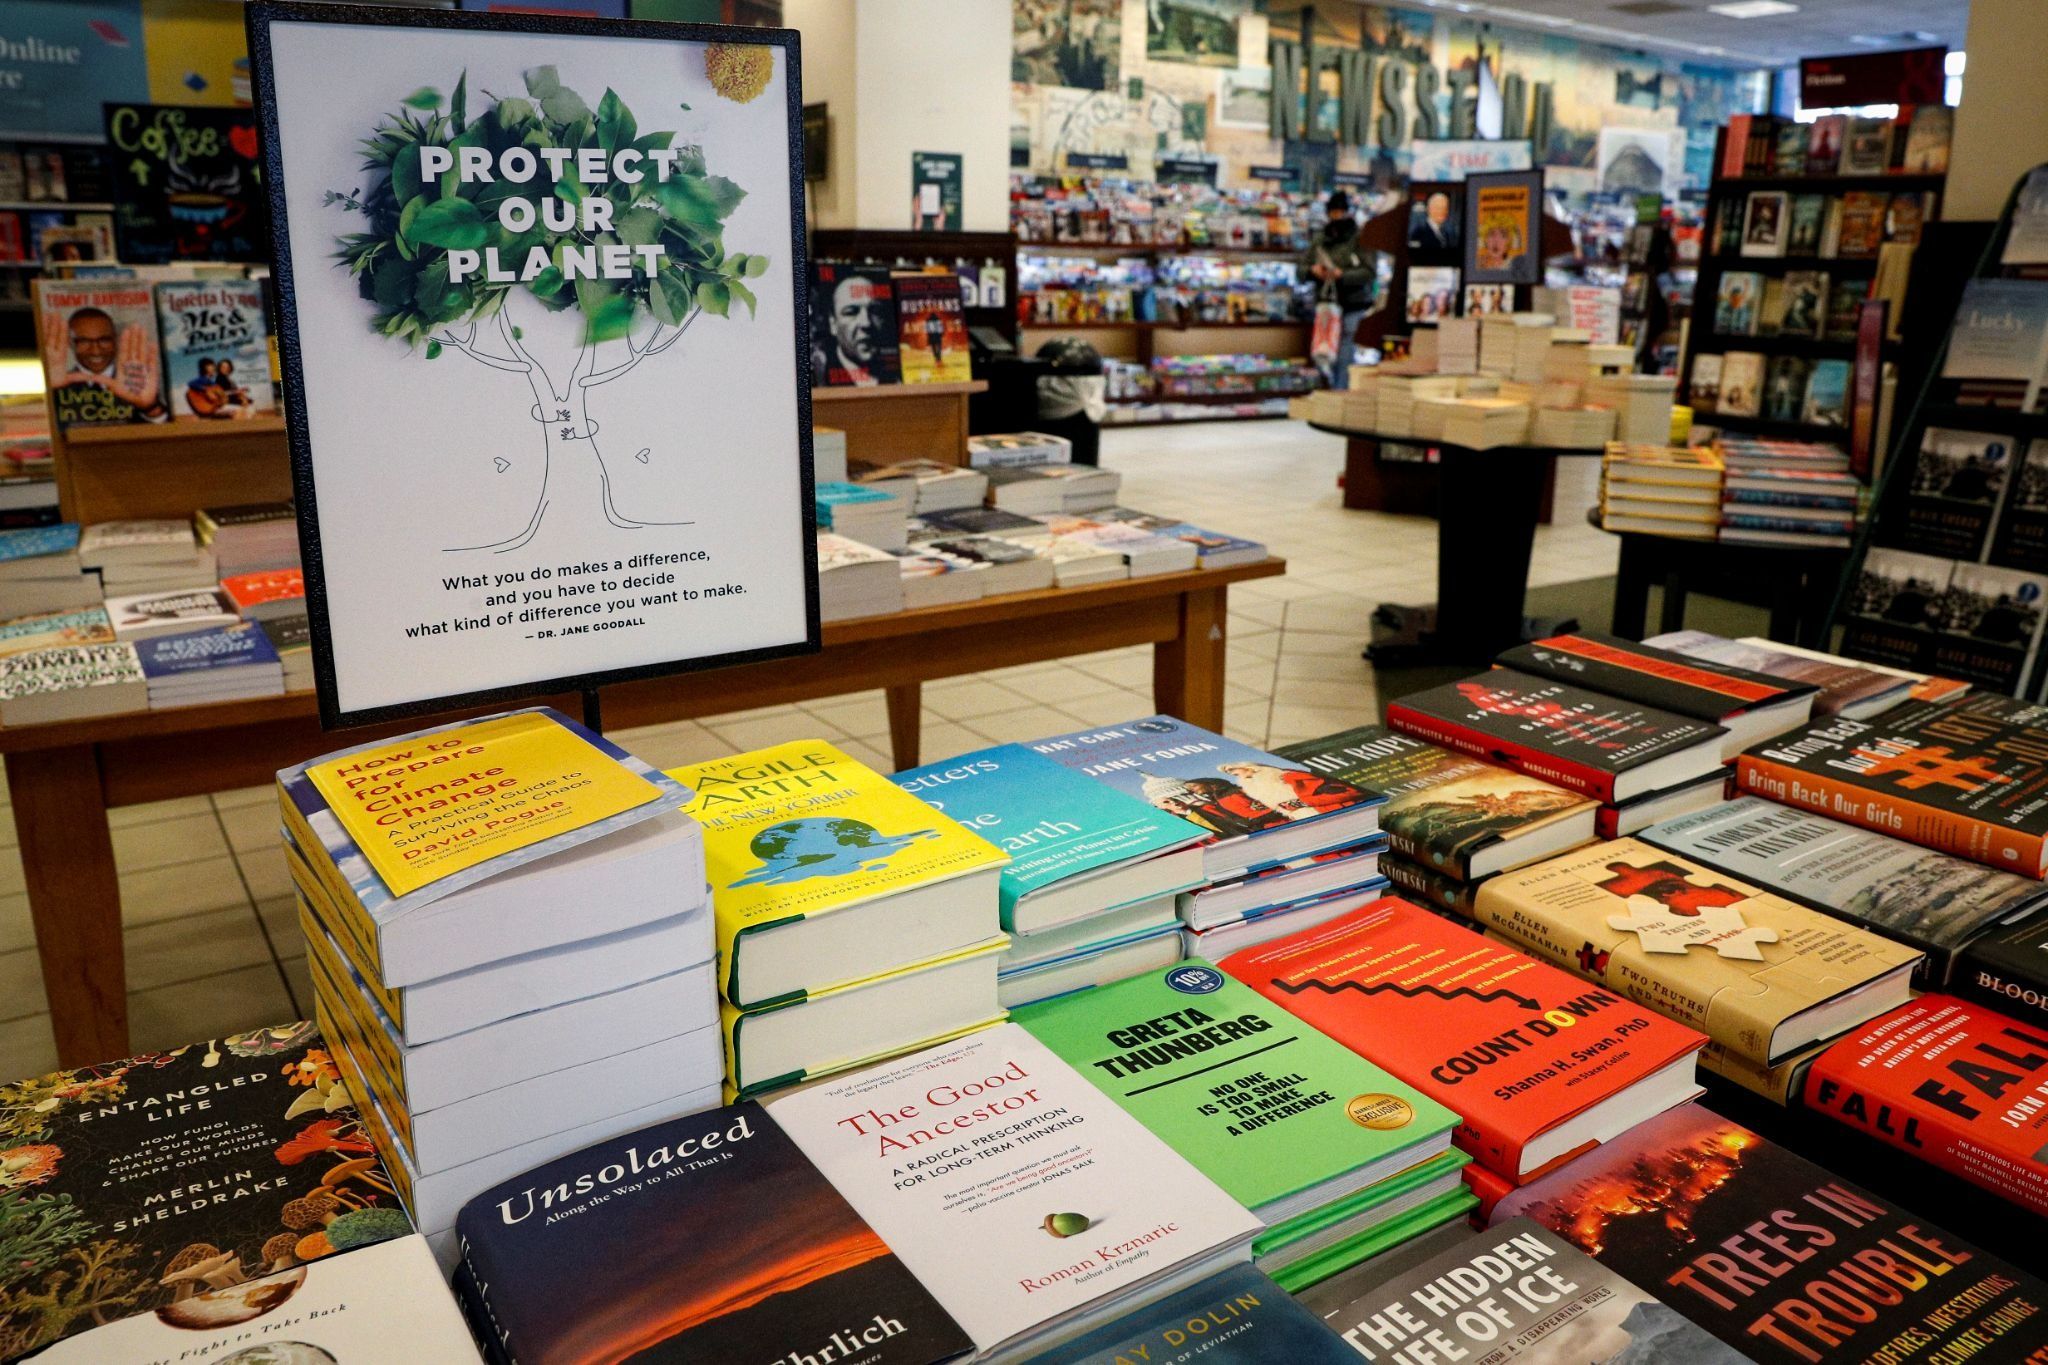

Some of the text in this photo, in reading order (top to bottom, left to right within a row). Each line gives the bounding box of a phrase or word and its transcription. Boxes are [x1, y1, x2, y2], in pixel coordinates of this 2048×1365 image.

[112, 107, 219, 165] Coffee
[420, 145, 677, 183] PROTECT
[499, 197, 615, 233] OUR
[448, 244, 665, 283] PLANET
[1968, 311, 2024, 331] Lucky
[59, 388, 114, 405] Living
[59, 402, 134, 421] in Color
[443, 549, 710, 591] What you do makes a difference,
[486, 572, 675, 607] and you have to decide
[405, 582, 747, 638] what kind of difference you want to make.
[538, 618, 645, 640] DR. JANE GOODALL
[1466, 687, 1564, 721] SPYMASTER
[1519, 703, 1595, 731] BAGHDAD
[1525, 704, 1547, 715] OF
[338, 739, 462, 777] How to
[347, 746, 485, 789] Prepare
[696, 753, 835, 791] AGILE
[699, 760, 741, 774] THE
[899, 758, 1000, 793] etters
[1083, 742, 1218, 776] JANE FONDA
[1523, 761, 1586, 787] MARGARET COKER
[354, 779, 404, 800] for
[365, 766, 505, 813] Climate
[376, 777, 518, 826] Change
[388, 771, 582, 839] A Practical Guide to
[678, 770, 839, 815] ARTH
[730, 788, 859, 823] NEW YORKER
[1749, 769, 1903, 829] Bring Back Our Girls
[394, 778, 592, 849] Surviving the Chaos
[403, 828, 477, 860] David
[487, 800, 565, 831] Pogue
[1001, 820, 1082, 853] arth
[1738, 823, 1838, 859] THAN HELL
[1514, 911, 1548, 934] ELLEN
[1175, 969, 1204, 987] 10%
[1621, 966, 1705, 1013] TWO TRUTHS
[1094, 1014, 1273, 1079] THUNBERG
[1106, 1007, 1216, 1051] GRETA
[1431, 990, 1619, 1085] COUNT DOWN
[1494, 1018, 1650, 1101] Shanna H. Swan, PhD
[79, 1072, 268, 1123] ENTANGLED
[837, 1062, 1031, 1137] The Good
[1196, 1073, 1308, 1117] IS TOO SMALL
[1209, 1071, 1271, 1098] NO ONE
[1229, 1088, 1304, 1120] TO MAKE
[148, 1099, 212, 1123] LIFE
[877, 1086, 1043, 1158] Ancestor
[1226, 1090, 1336, 1137] A DIFFERENCE
[1356, 1101, 1406, 1123] EXCLUSIVE
[1818, 1078, 1924, 1149] FALL
[2000, 1095, 2047, 1128] JOHN
[108, 1132, 265, 1175] CHANGE OUR MINDS
[109, 1123, 264, 1165] MAKE OUR WORLDS,
[140, 1121, 229, 1147] HOW FUNGI
[893, 1107, 1069, 1178] A RADICAL PRESCRIPTION
[894, 1114, 1085, 1191] FOR LONG-TERM THINKING
[120, 1165, 169, 1183] SHAPE
[176, 1155, 207, 1168] OUR
[214, 1137, 278, 1158] FUTURES
[495, 1116, 755, 1226] Unsolaced
[113, 1176, 289, 1232] SHELDRAKE
[144, 1169, 253, 1207] MERLIN
[544, 1150, 733, 1226] Along the Way to All That Is
[1018, 1220, 1181, 1295] Roman Krznaric
[1074, 1248, 1150, 1286] Author of Empathy
[1666, 1183, 1888, 1311] TREES IN
[1341, 1233, 1557, 1361] THE HIDDEN
[1455, 1265, 1579, 1343] OF ICE
[1747, 1224, 1973, 1364] TROUBLE
[1923, 1275, 2020, 1331] INFESTATIONS,
[180, 1303, 347, 1361] Fight to Take Back
[1163, 1293, 1261, 1347] DOLIN
[1507, 1286, 1613, 1354] A DISAPPEARING WORLD
[1928, 1297, 2039, 1365] CLIMATE CHANGE
[1177, 1322, 1253, 1362] OF LEVIATHAN
